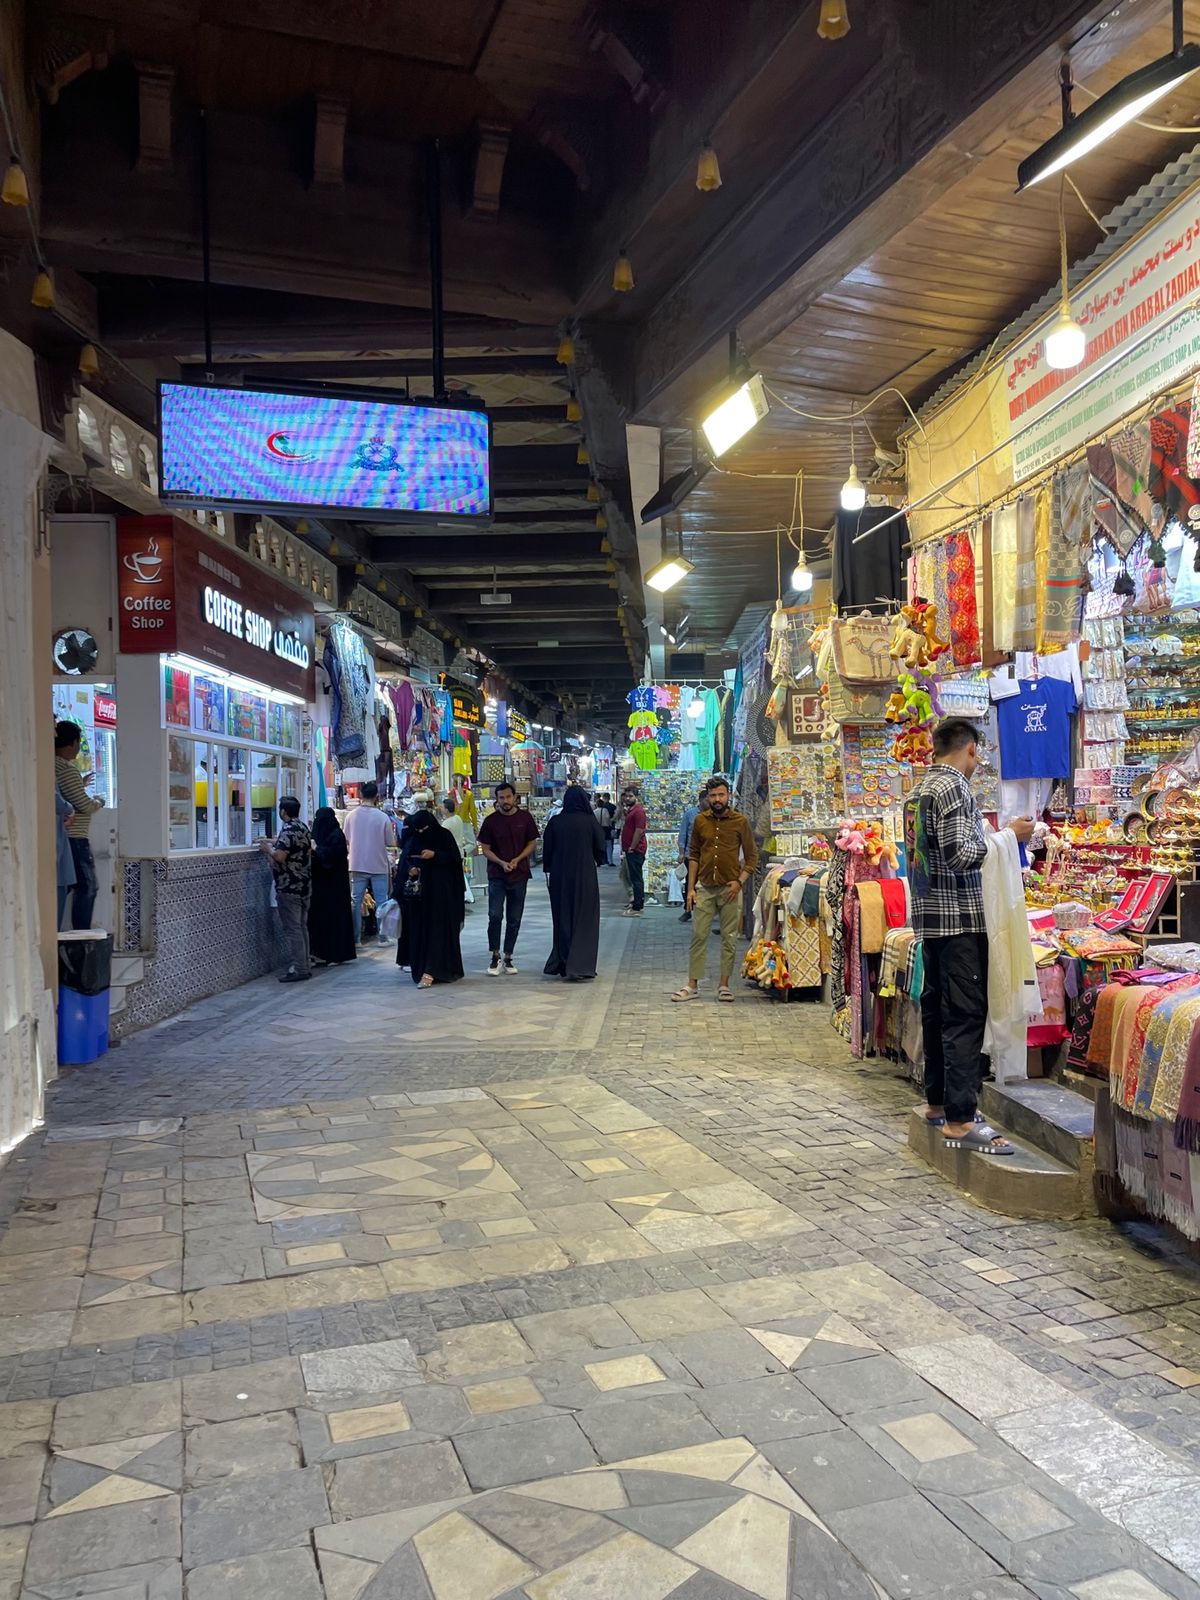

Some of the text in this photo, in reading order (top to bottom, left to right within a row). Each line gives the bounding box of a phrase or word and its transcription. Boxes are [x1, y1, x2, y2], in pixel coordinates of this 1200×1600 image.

[1129, 251, 1161, 288] محمد
[1112, 278, 1129, 306] بن
[1114, 314, 1129, 346] BIN
[1130, 297, 1155, 335] ARAB
[124, 596, 171, 611] Coffee
[204, 586, 272, 652] COFFEE SHOP
[131, 616, 164, 629] Shop
